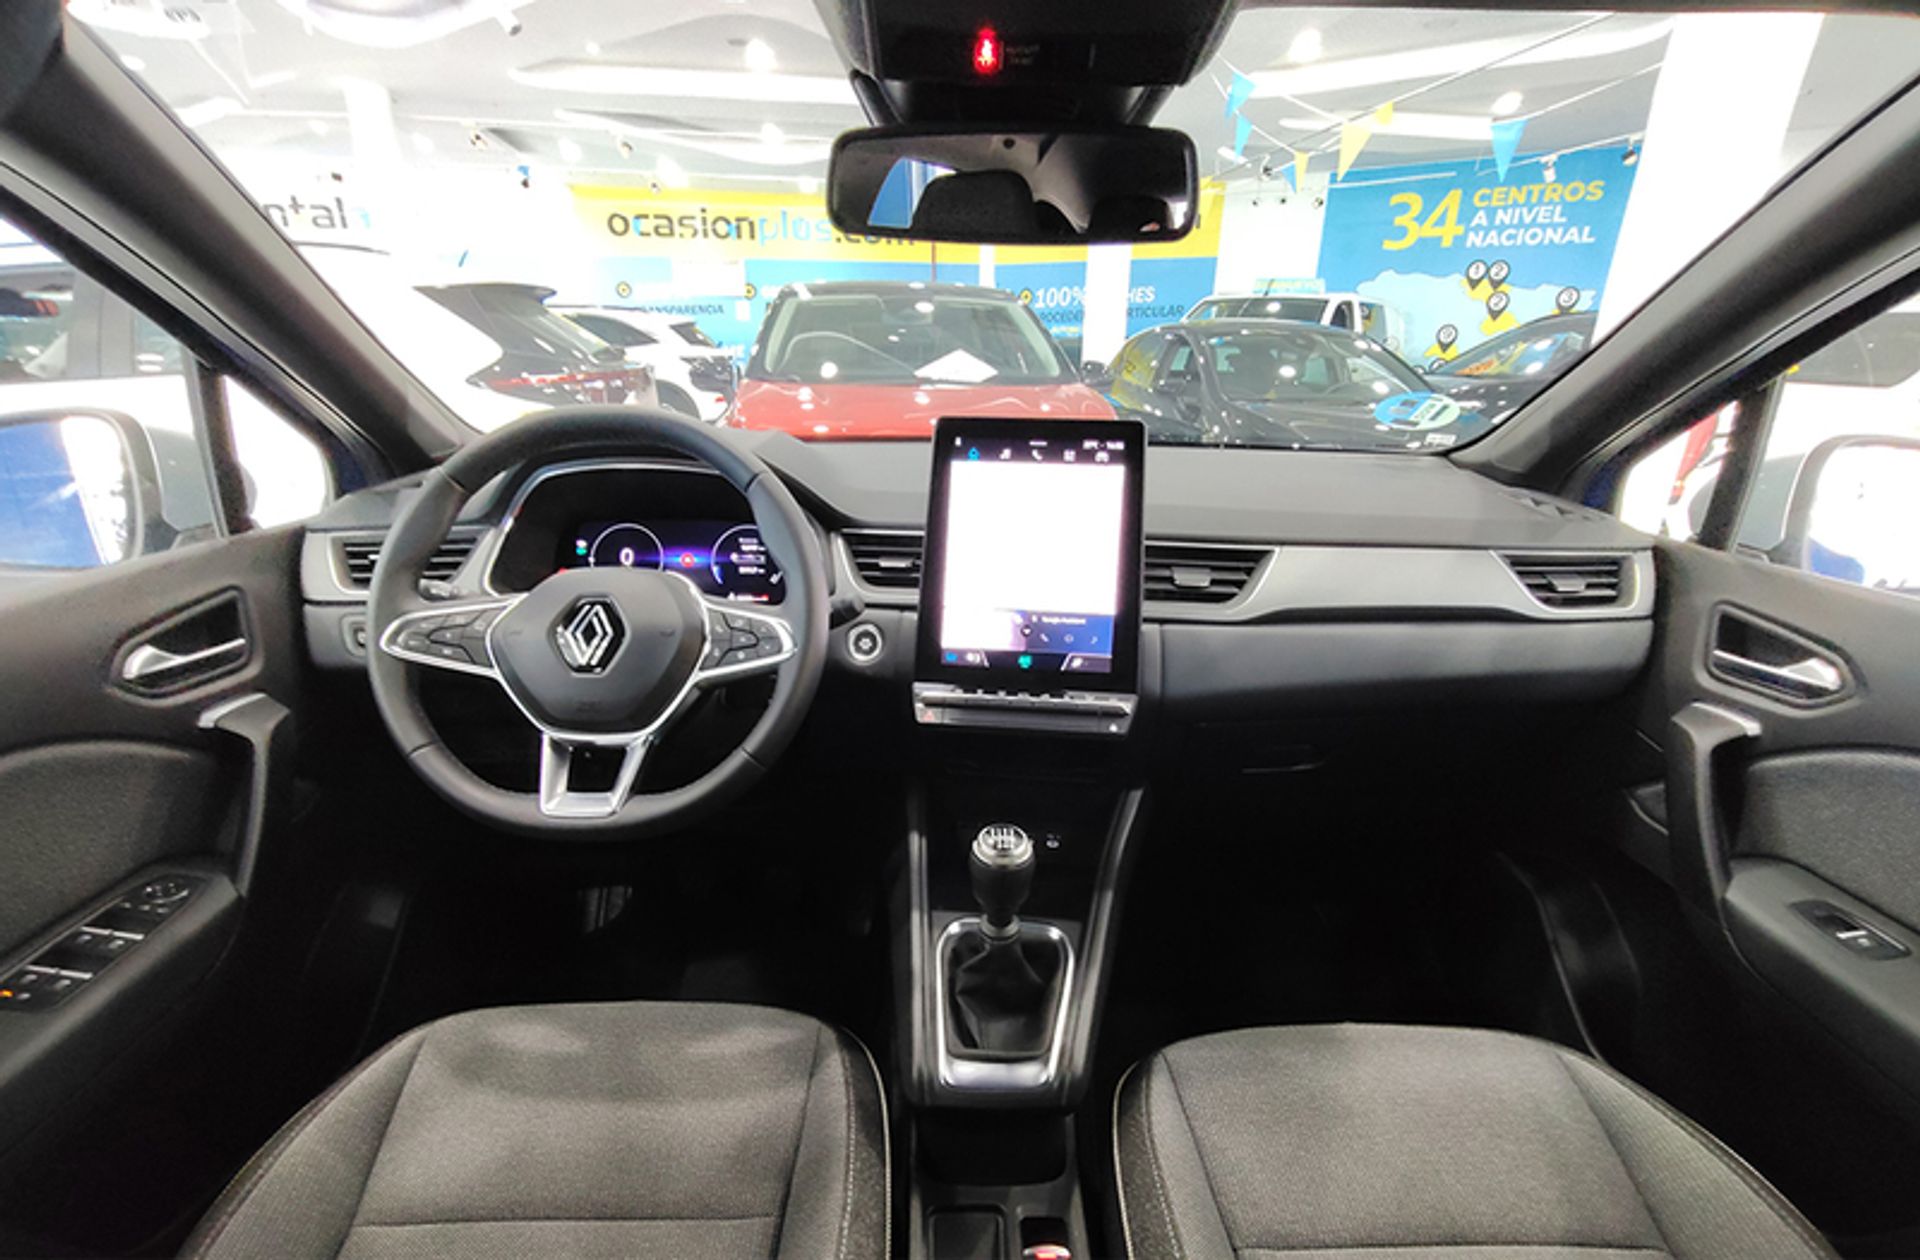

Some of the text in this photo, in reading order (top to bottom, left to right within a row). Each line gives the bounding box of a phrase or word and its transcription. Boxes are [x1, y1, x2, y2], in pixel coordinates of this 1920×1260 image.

[1474, 181, 1604, 206] CENTROS
[607, 207, 917, 246] ocasionplus.
[1383, 189, 1464, 249] 34
[1470, 205, 1566, 226] A NIVEL
[1466, 227, 1595, 247] NACIONAL
[620, 548, 634, 566] 0
